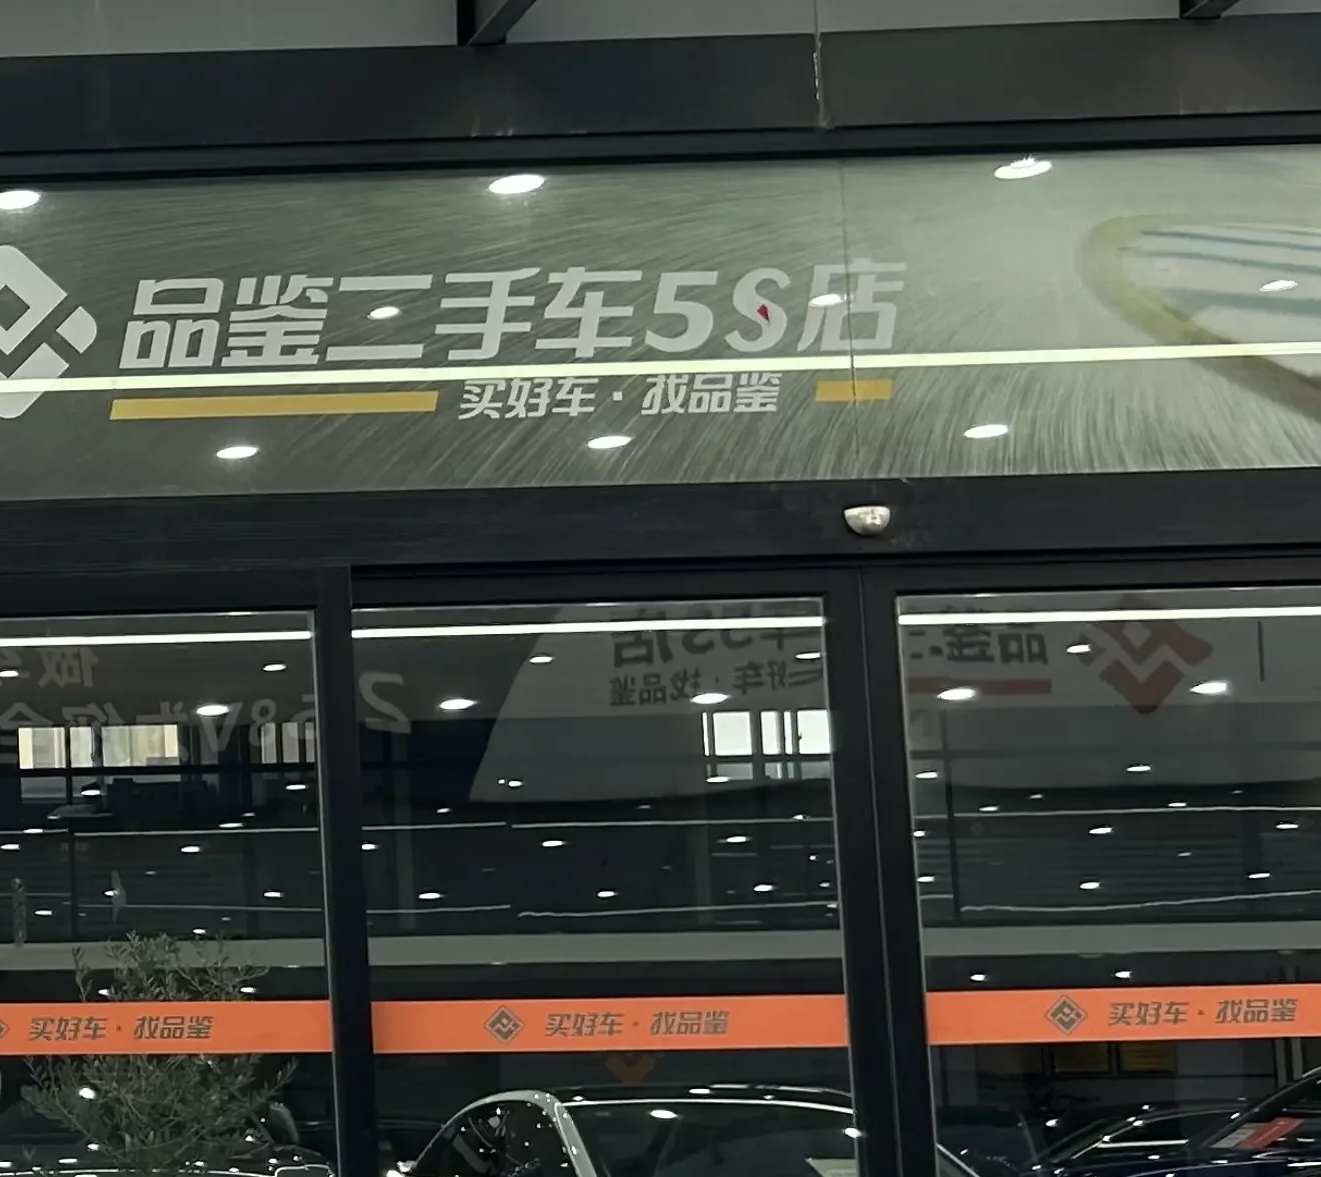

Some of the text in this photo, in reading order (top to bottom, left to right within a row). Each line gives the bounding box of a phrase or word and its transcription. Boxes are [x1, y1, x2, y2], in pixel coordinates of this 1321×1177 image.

[119, 258, 907, 369] 品鉴二手车5S店
